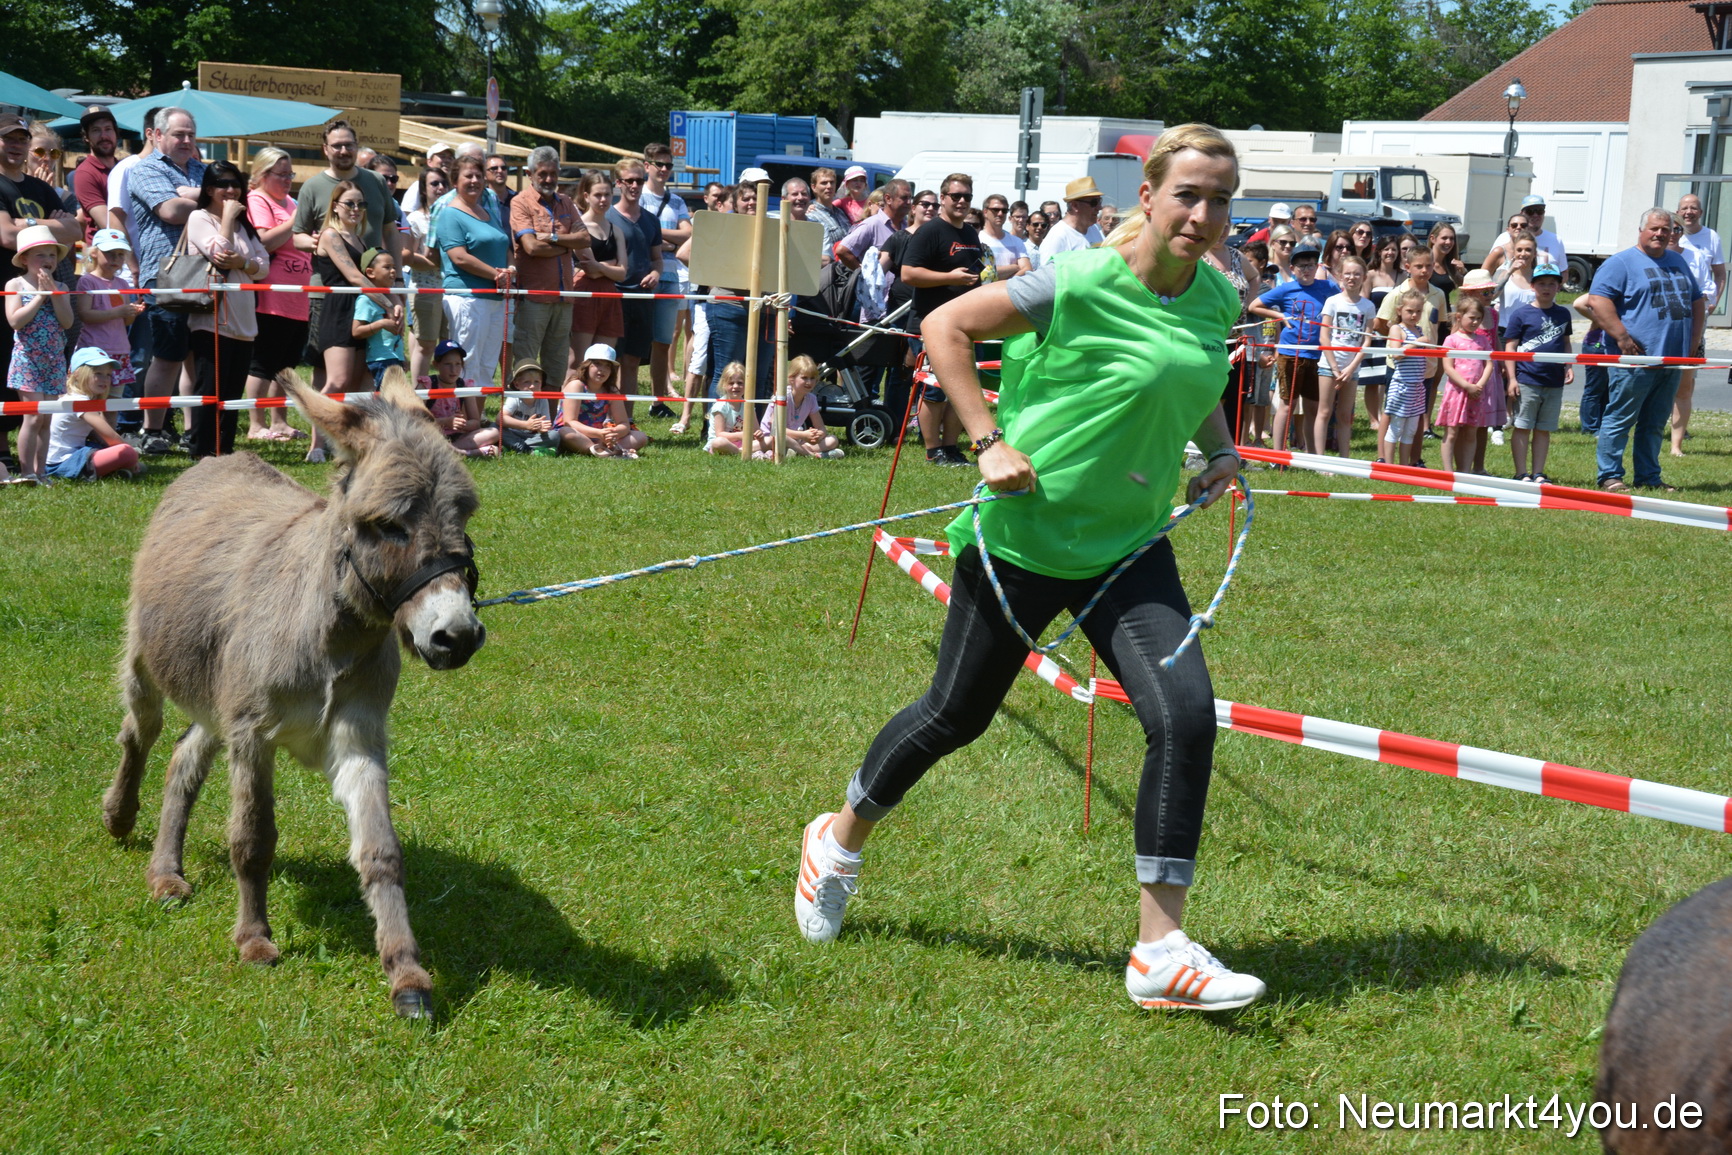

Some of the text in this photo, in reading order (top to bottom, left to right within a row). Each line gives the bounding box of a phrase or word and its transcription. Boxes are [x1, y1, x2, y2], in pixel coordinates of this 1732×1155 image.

[208, 70, 326, 100] Stauferbergesel
[673, 114, 684, 134] P
[673, 141, 684, 154] P2
[284, 260, 313, 274] SEA
